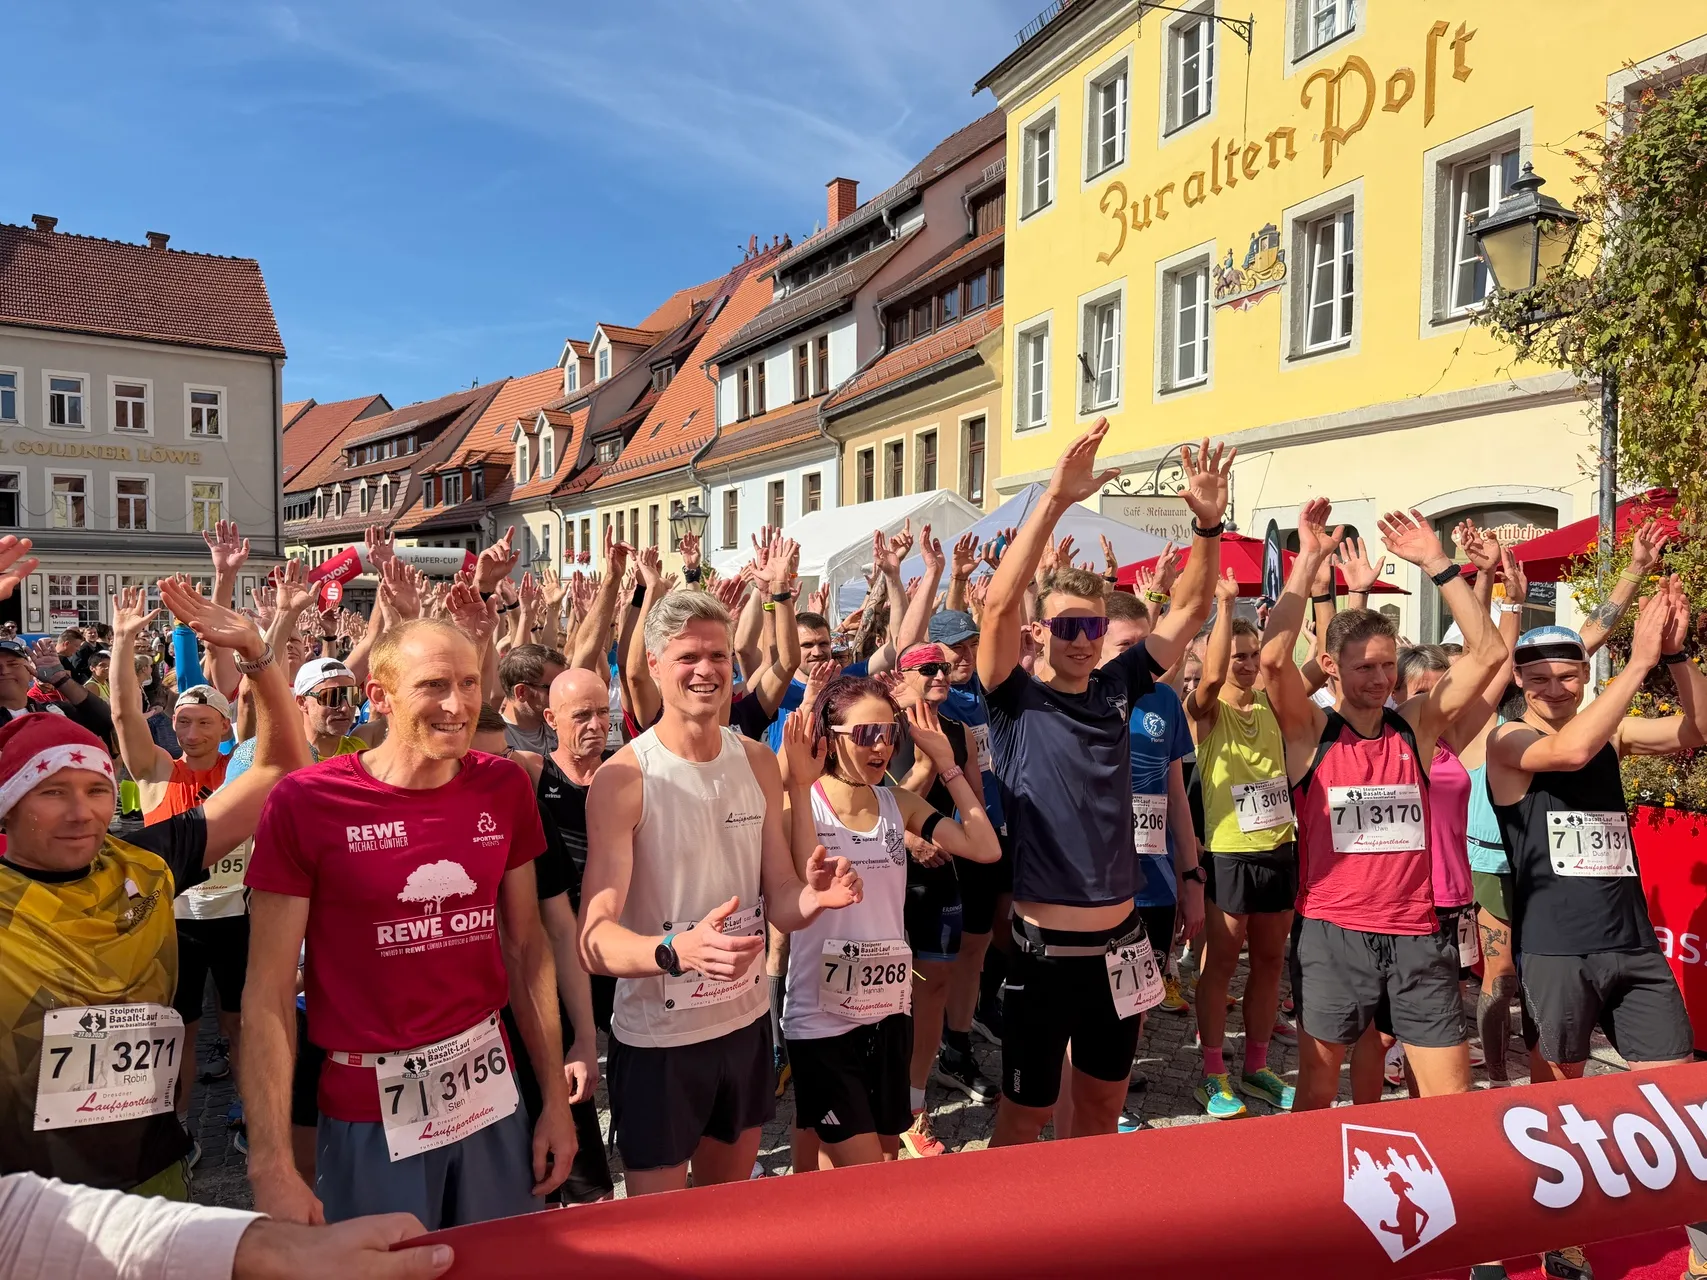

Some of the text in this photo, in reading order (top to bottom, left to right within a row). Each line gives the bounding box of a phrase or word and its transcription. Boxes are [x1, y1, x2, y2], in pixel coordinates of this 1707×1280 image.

[1097, 181, 1174, 265] Zur
[1183, 127, 1297, 207] alten
[13, 440, 132, 462] GOLDNER
[139, 445, 201, 465] LÖWE
[1124, 507, 1141, 516] Café
[1140, 524, 1167, 539] lten
[410, 555, 459, 564] LÄUFER-CUP
[321, 562, 350, 583] ZVON
[1236, 789, 1289, 812] 7 3018
[1333, 804, 1422, 825] 7 3170
[346, 821, 407, 843] REWE
[472, 834, 505, 843] SPORTWERK
[348, 837, 409, 853] MICHAEL GÜNTHER
[1552, 831, 1628, 850] 7 3131
[377, 917, 443, 945] REWE
[450, 908, 495, 932] QDH
[1459, 928, 1468, 944] 7
[405, 945, 426, 954] REWE
[861, 945, 891, 953] Basalt-Lauf
[825, 963, 907, 987] 7 3268
[1111, 969, 1123, 990] 7
[863, 987, 885, 995] Hannah
[109, 1007, 146, 1015] Stolpener
[840, 996, 893, 1013] Laufsportladen
[109, 1012, 158, 1023] Basalt-Lauf
[427, 1039, 458, 1055] Stolpener
[428, 1038, 470, 1063] Basalt-Lauf
[50, 1038, 176, 1079] 7 3271
[123, 1074, 147, 1084] Robin
[385, 1047, 506, 1115] 7 3156
[1013, 1068, 1021, 1094] FUSION
[102, 1091, 133, 1099] Dresdner
[448, 1098, 466, 1112] Sten
[74, 1115, 105, 1124] running
[115, 1111, 136, 1119] skiing
[418, 1106, 495, 1141] Laufsportladen
[420, 1141, 444, 1150] running
